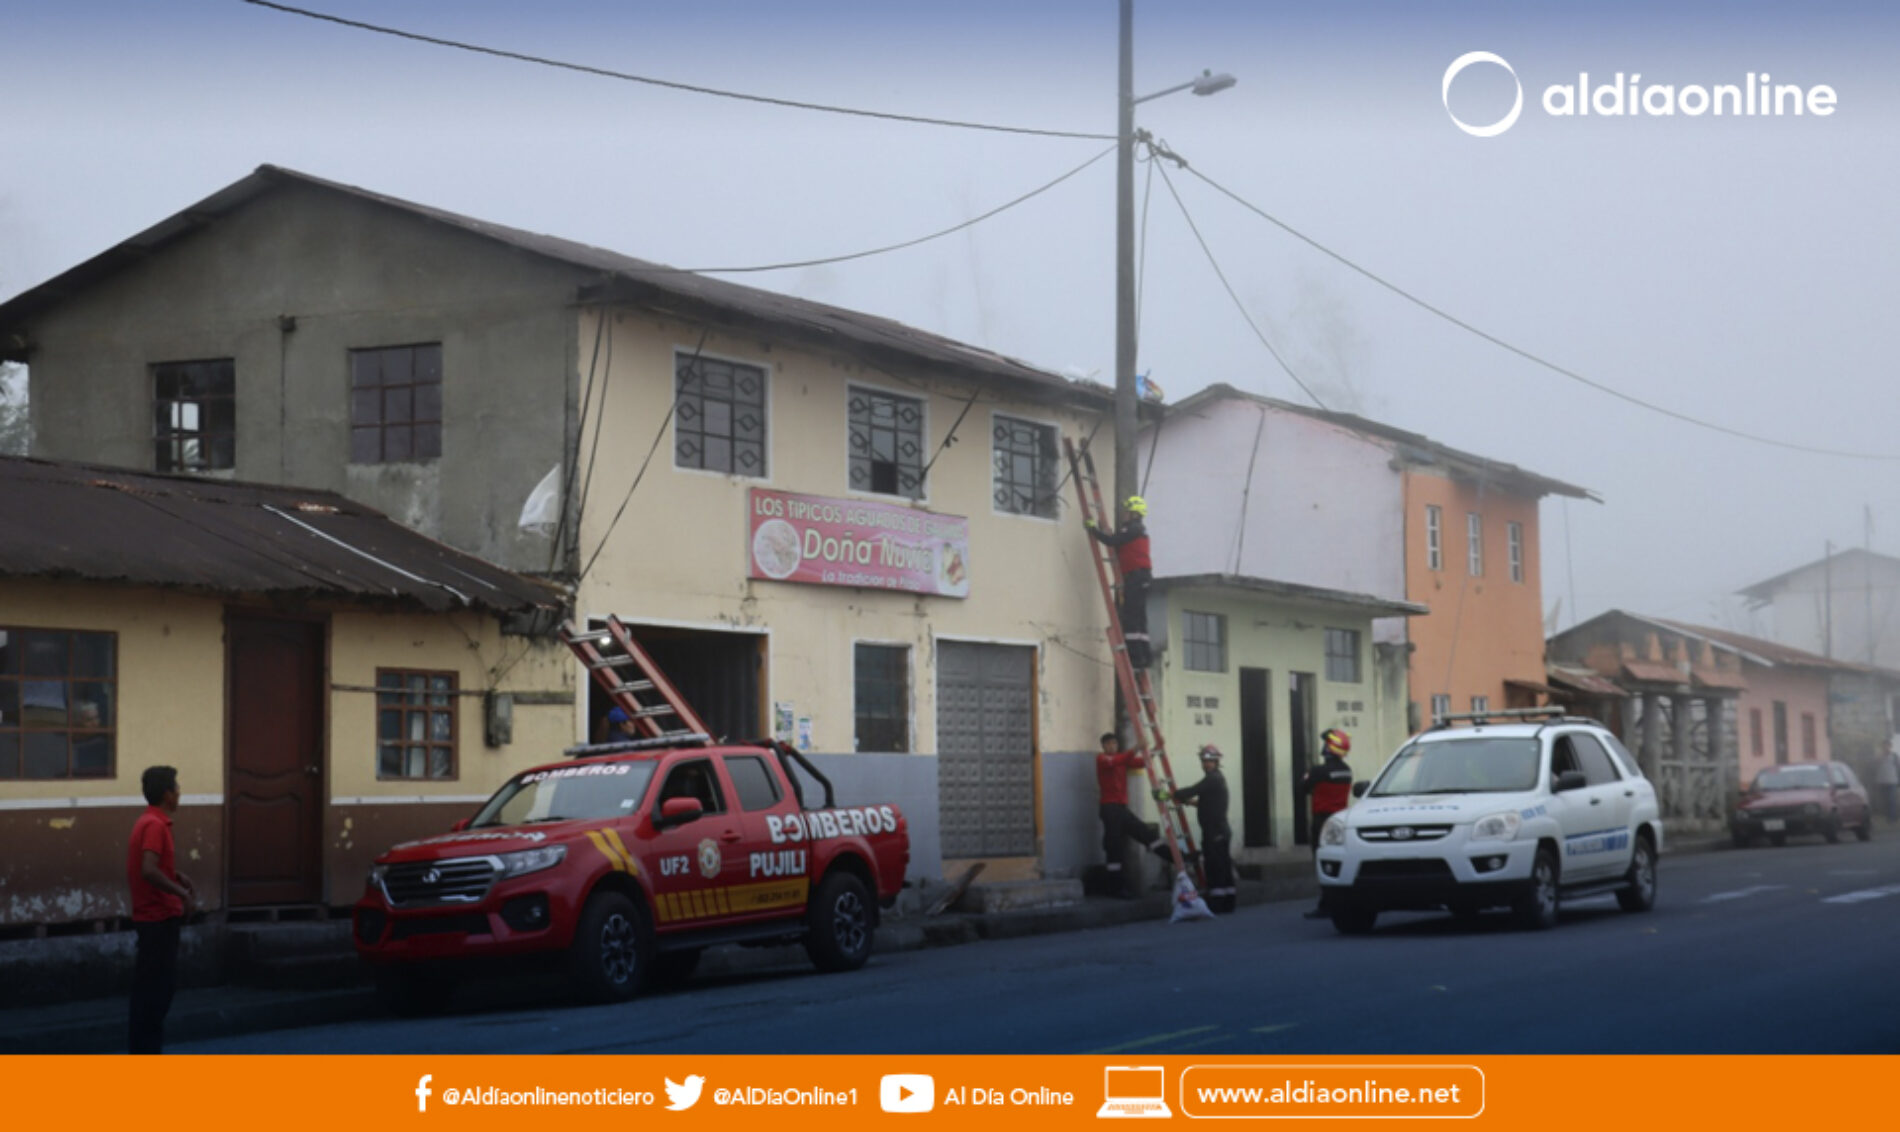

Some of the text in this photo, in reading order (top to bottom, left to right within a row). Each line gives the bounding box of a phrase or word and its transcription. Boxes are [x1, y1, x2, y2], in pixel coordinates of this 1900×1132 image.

[756, 496, 784, 517] LOS
[787, 499, 842, 523] TIPICOS
[802, 527, 872, 565] Doña
[520, 764, 632, 785] BOMBEROS
[766, 804, 897, 844] BOMBEROS
[660, 855, 690, 876] UF2
[750, 849, 806, 878] PUJILI
